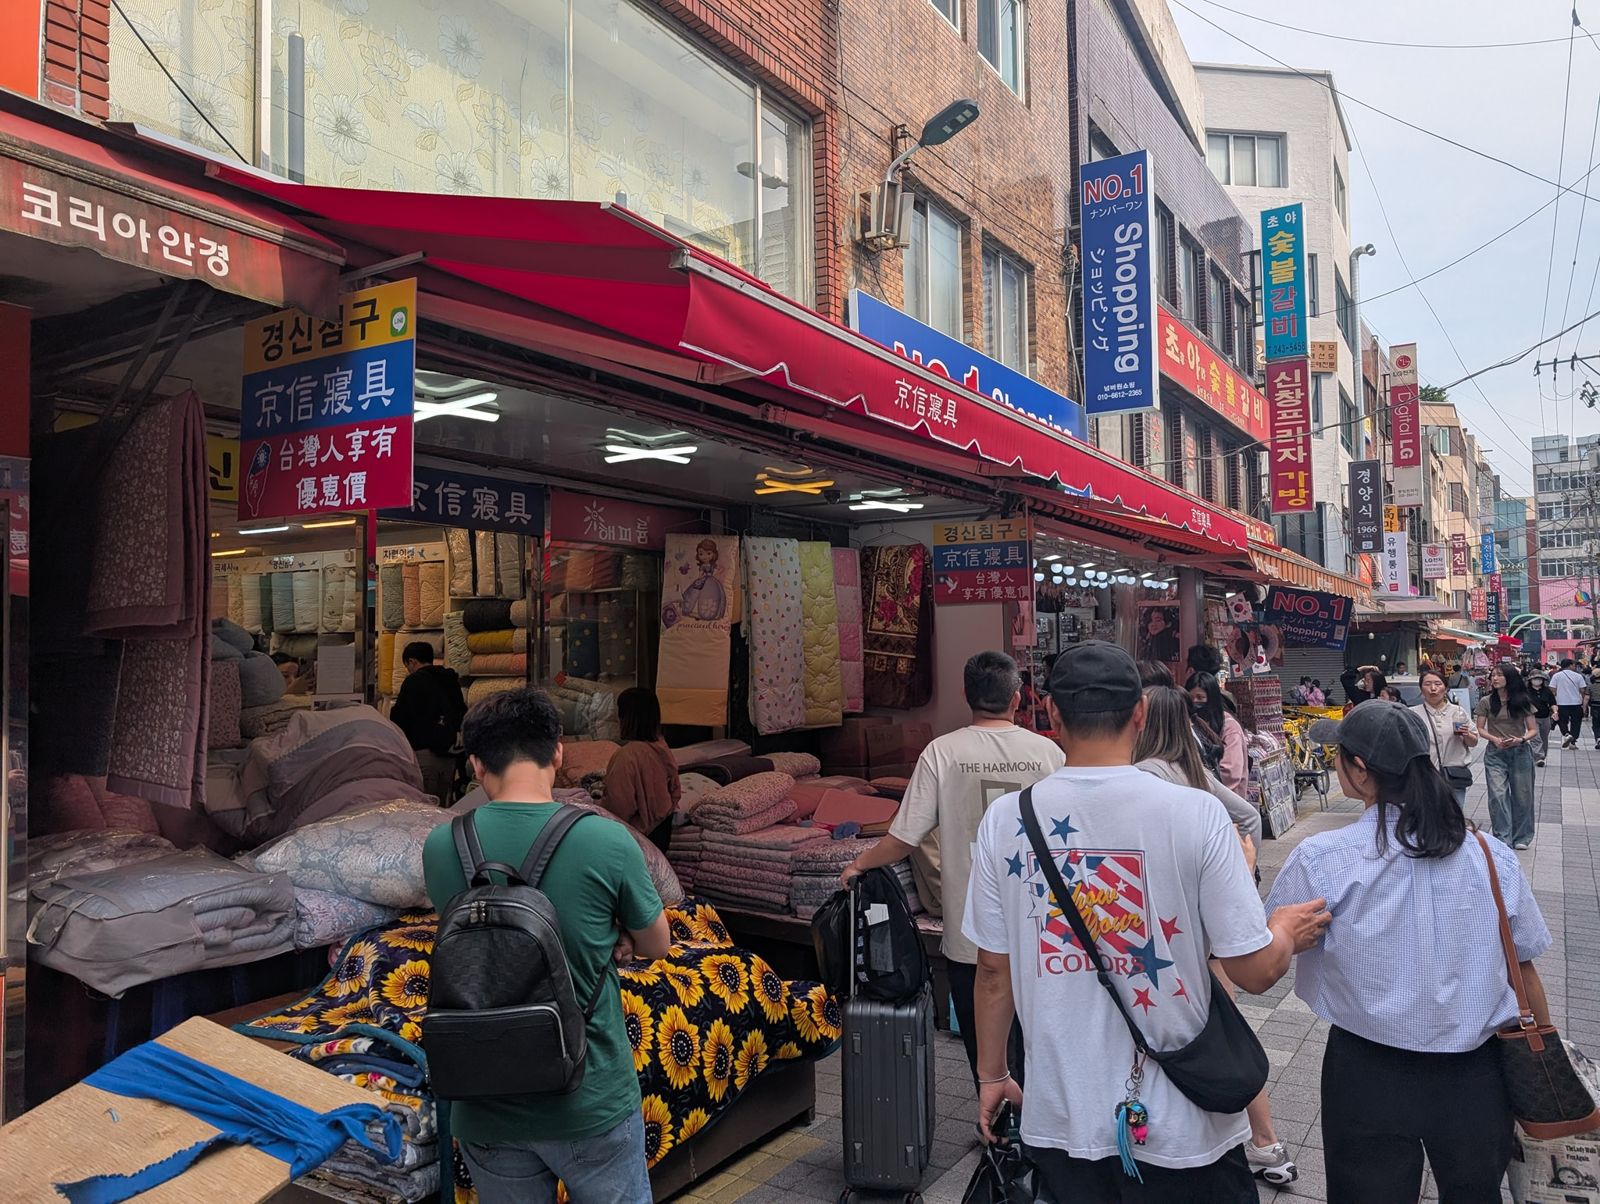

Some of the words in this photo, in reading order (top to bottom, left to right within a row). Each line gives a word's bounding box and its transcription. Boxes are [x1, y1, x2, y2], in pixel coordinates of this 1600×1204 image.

[1083, 163, 1144, 206] NO.1
[1089, 200, 1143, 220] ナンバーワン
[1266, 211, 1297, 229] 초야
[21, 181, 230, 278] 코리아안경
[1113, 221, 1145, 374] Shopping
[1267, 230, 1298, 338] 숯불갈비
[1090, 247, 1109, 352] ショッピング
[1394, 392, 1413, 436] Digital
[1400, 439, 1414, 460] LG
[1278, 470, 1309, 508] 가방
[1356, 468, 1375, 519] 경양식
[944, 523, 1013, 542] 경신침구
[1357, 525, 1378, 534] 1966
[1272, 592, 1345, 620] NO.1
[1280, 615, 1332, 629] ナンバーワン
[1280, 623, 1328, 639] Shopping
[959, 762, 980, 773] THE
[982, 761, 1042, 773] HARMONY
